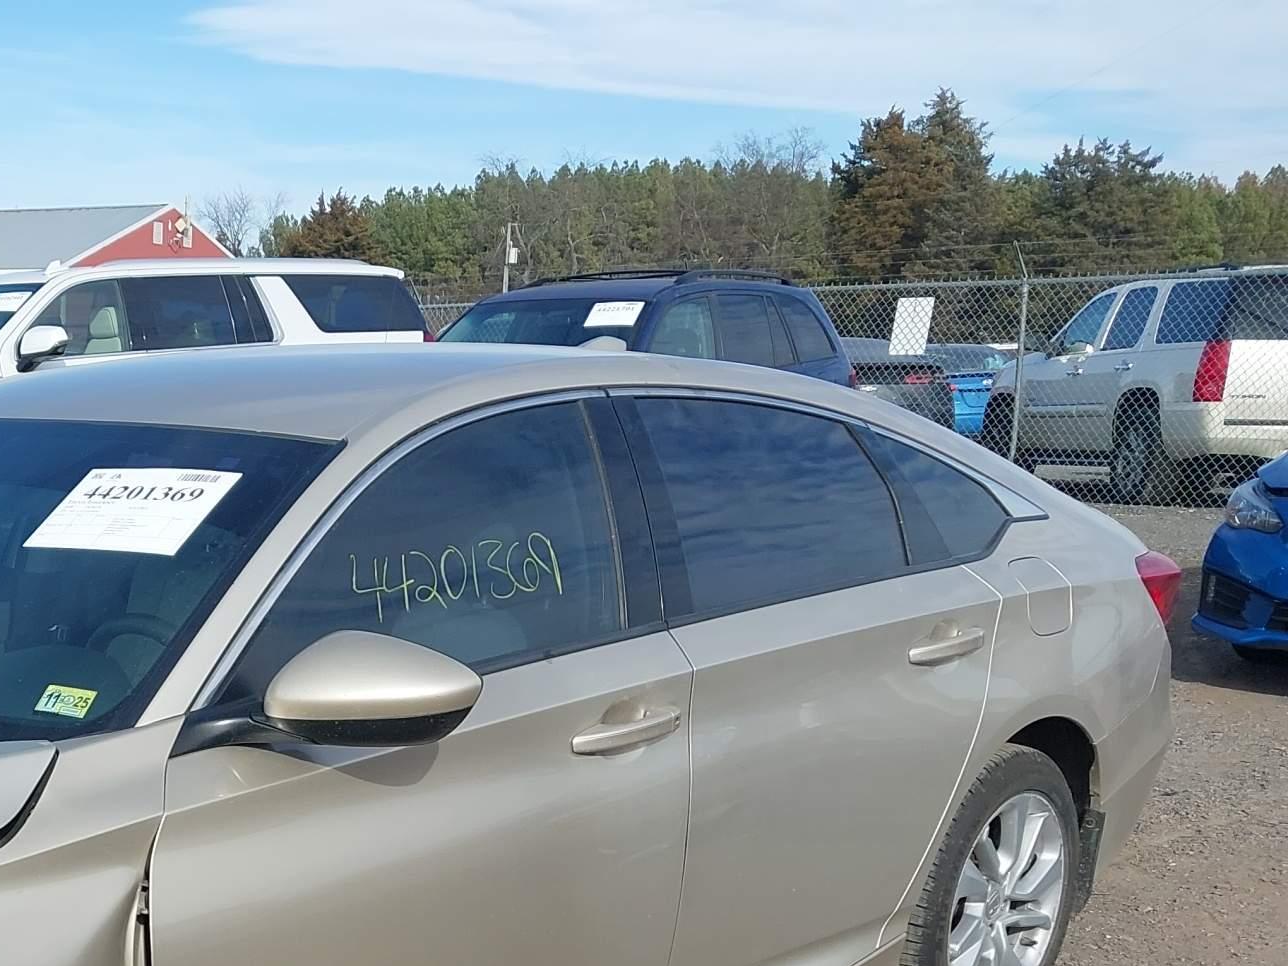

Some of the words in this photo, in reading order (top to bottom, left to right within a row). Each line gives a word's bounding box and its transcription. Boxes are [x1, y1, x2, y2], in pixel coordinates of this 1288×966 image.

[83, 484, 205, 503] 44201369
[349, 532, 563, 624] 44201369
[44, 691, 63, 709] 11
[72, 695, 92, 709] 25
